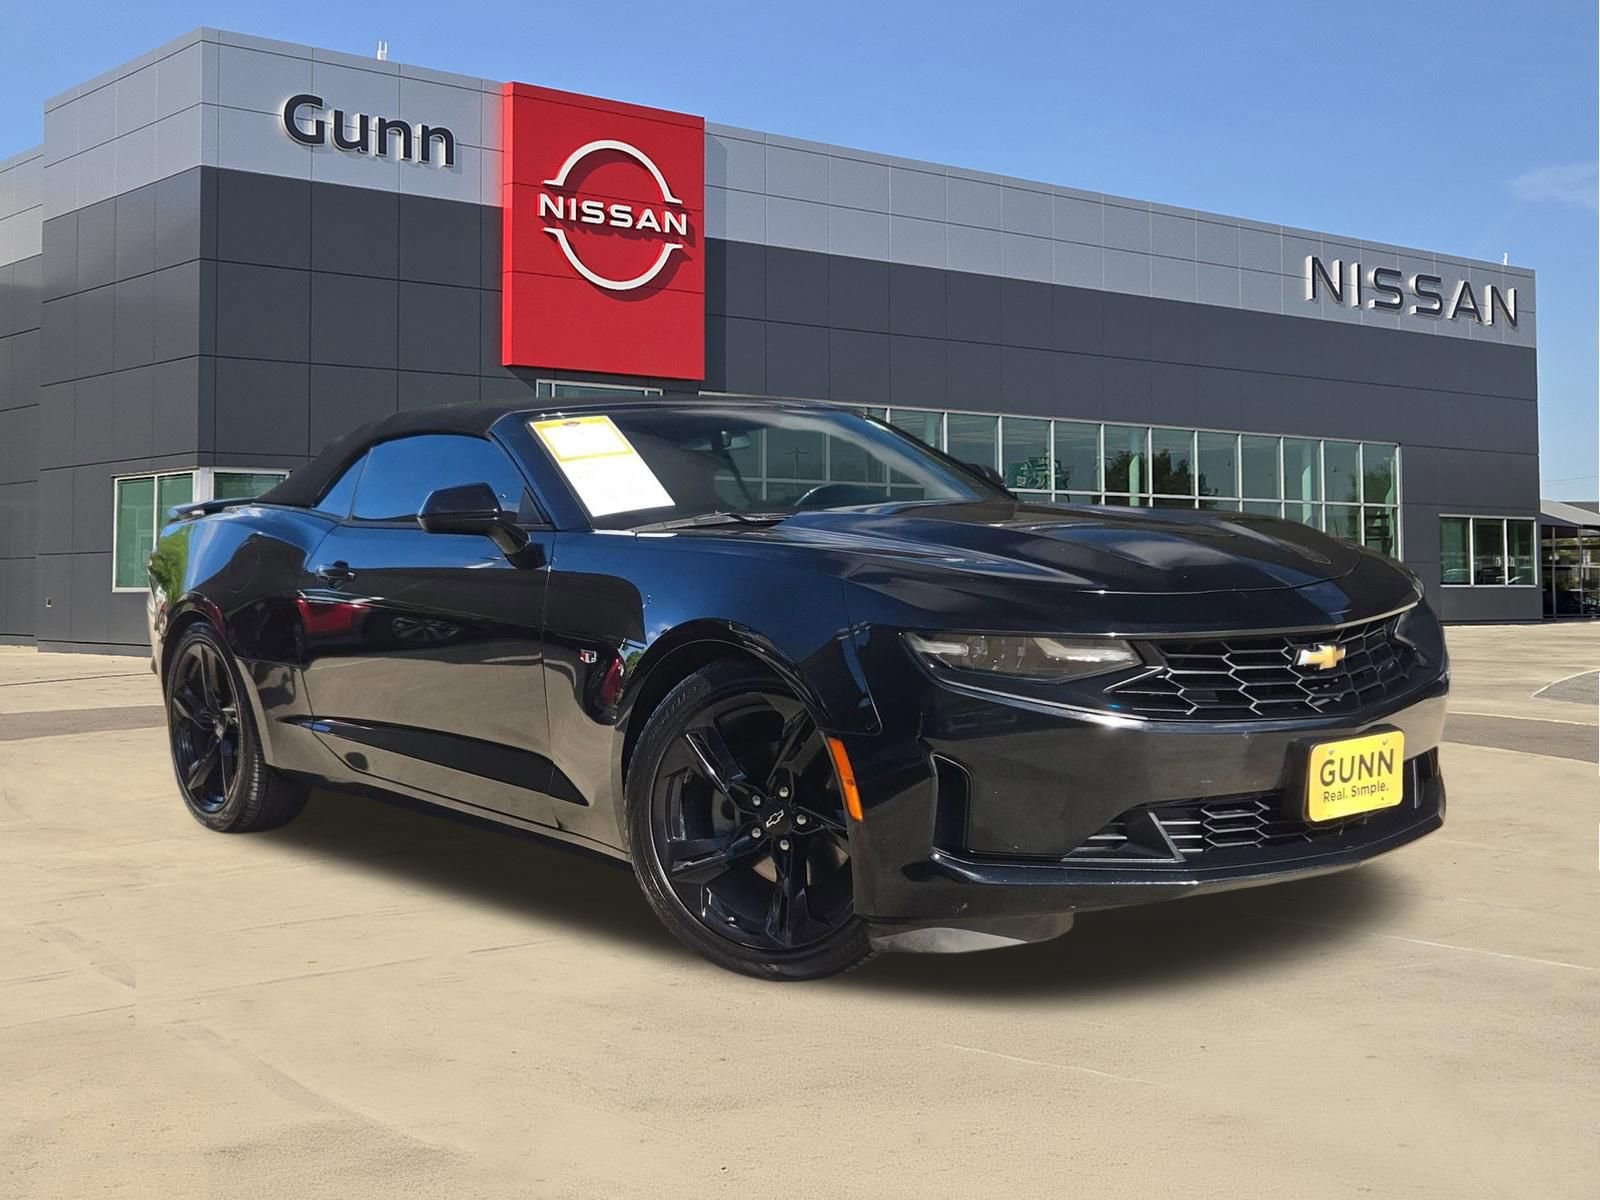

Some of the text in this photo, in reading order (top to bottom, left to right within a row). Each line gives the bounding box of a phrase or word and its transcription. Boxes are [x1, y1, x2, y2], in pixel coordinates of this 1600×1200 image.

[282, 93, 455, 168] Gunn
[538, 192, 687, 236] NISSAN
[1305, 255, 1518, 328] NISSAN
[1319, 748, 1395, 787] GUNN
[1323, 780, 1390, 803] Real. Simple.
